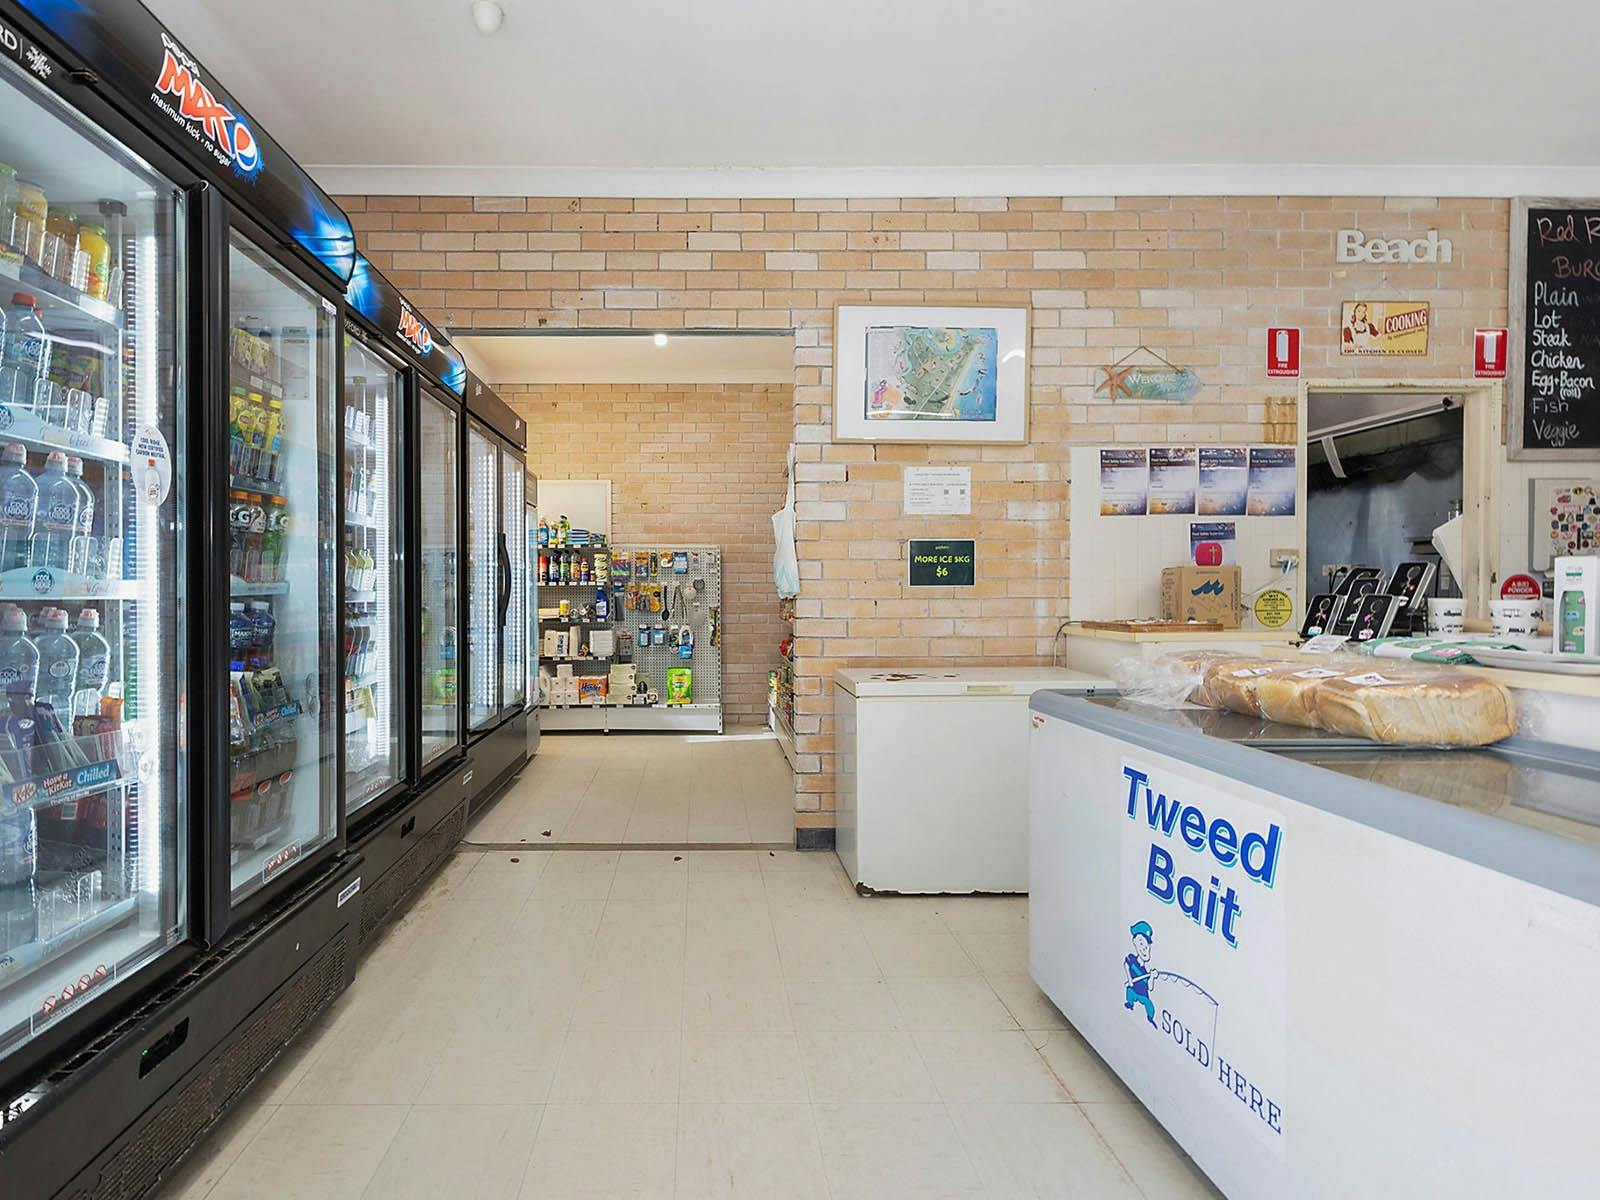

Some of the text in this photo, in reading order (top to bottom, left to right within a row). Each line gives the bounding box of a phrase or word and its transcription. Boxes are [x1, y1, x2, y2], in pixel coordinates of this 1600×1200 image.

[155, 49, 236, 159] MAX
[151, 92, 232, 168] maximum kick no sugar
[1537, 214, 1579, 248] Red
[1336, 228, 1452, 264] Beach
[1534, 280, 1580, 307] Plain
[1385, 310, 1427, 333] COOKING
[1534, 307, 1562, 329] Lot
[1532, 327, 1572, 347] Steak
[1531, 349, 1585, 370] Chicken
[1531, 397, 1569, 414] Fish
[1532, 418, 1580, 447] Veggie
[914, 555, 938, 564] MORE
[939, 555, 953, 563] ICE
[936, 565, 949, 578] $6
[77, 763, 110, 785] Chilled
[1123, 765, 1283, 888] Tweed
[1146, 842, 1242, 949] Bait
[1161, 1009, 1282, 1135] SOLD HERE
